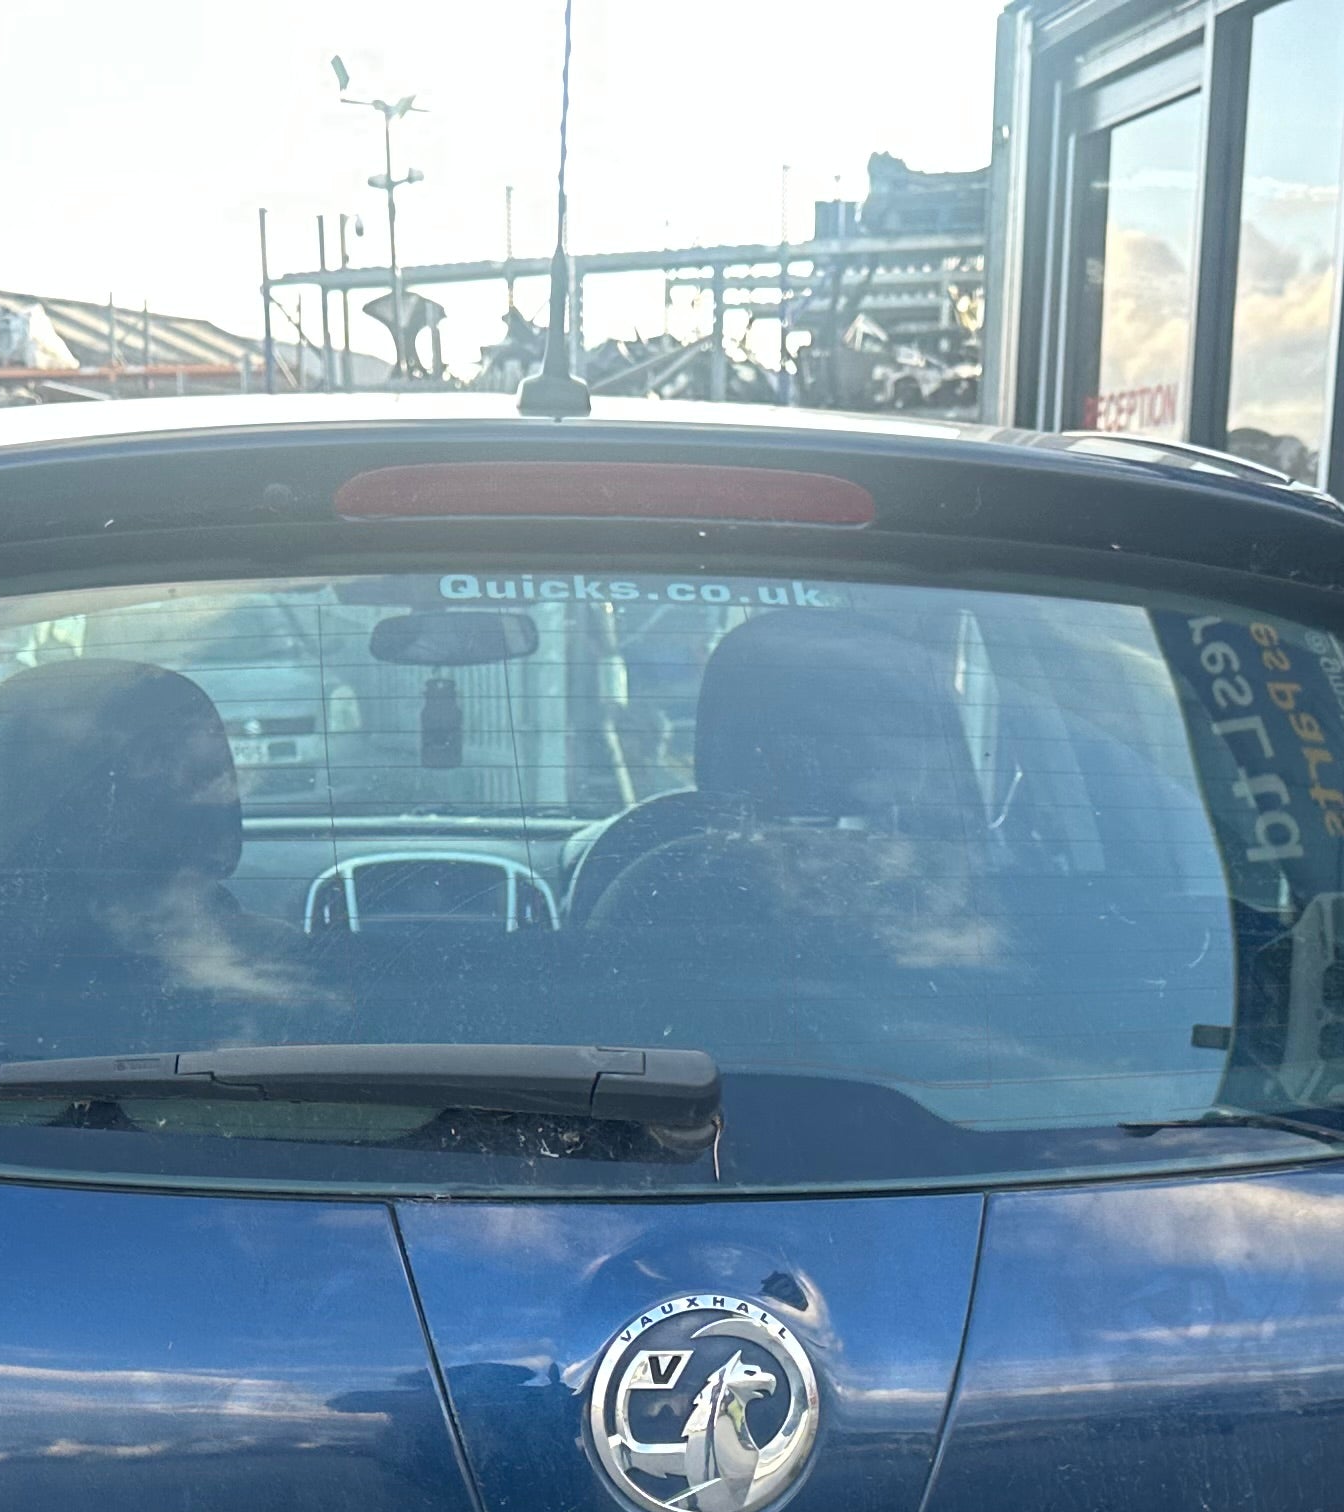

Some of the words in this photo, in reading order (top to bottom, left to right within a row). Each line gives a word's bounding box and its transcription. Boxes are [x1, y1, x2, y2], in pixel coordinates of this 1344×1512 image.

[1083, 384, 1178, 431] RECEPTION
[439, 574, 822, 608] Quicks.co.uk
[619, 1295, 788, 1343] VAUXHALL
[648, 1355, 683, 1385] V
